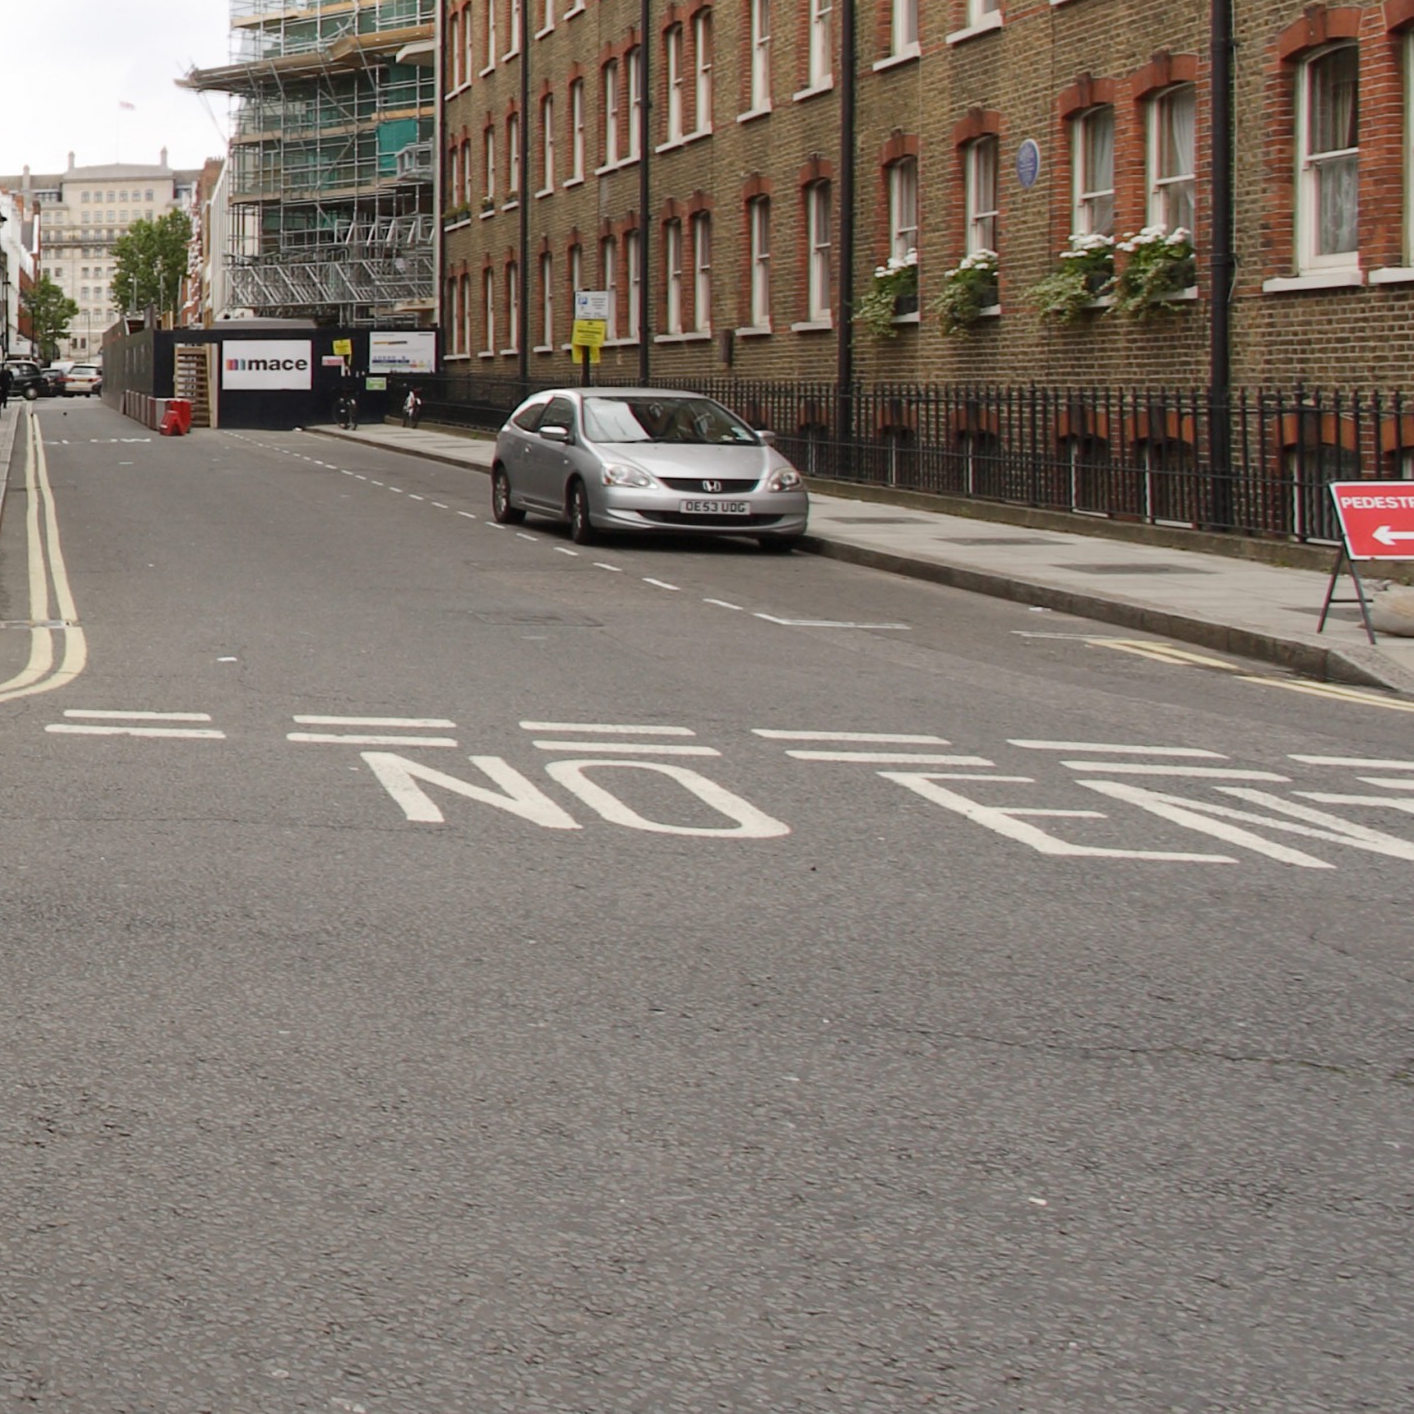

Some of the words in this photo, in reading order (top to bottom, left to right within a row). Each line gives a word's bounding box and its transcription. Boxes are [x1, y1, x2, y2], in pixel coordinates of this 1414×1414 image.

[248, 358, 308, 371] mace
[685, 501, 718, 512] OE53
[721, 502, 746, 513] UDG
[360, 751, 791, 838] NO
